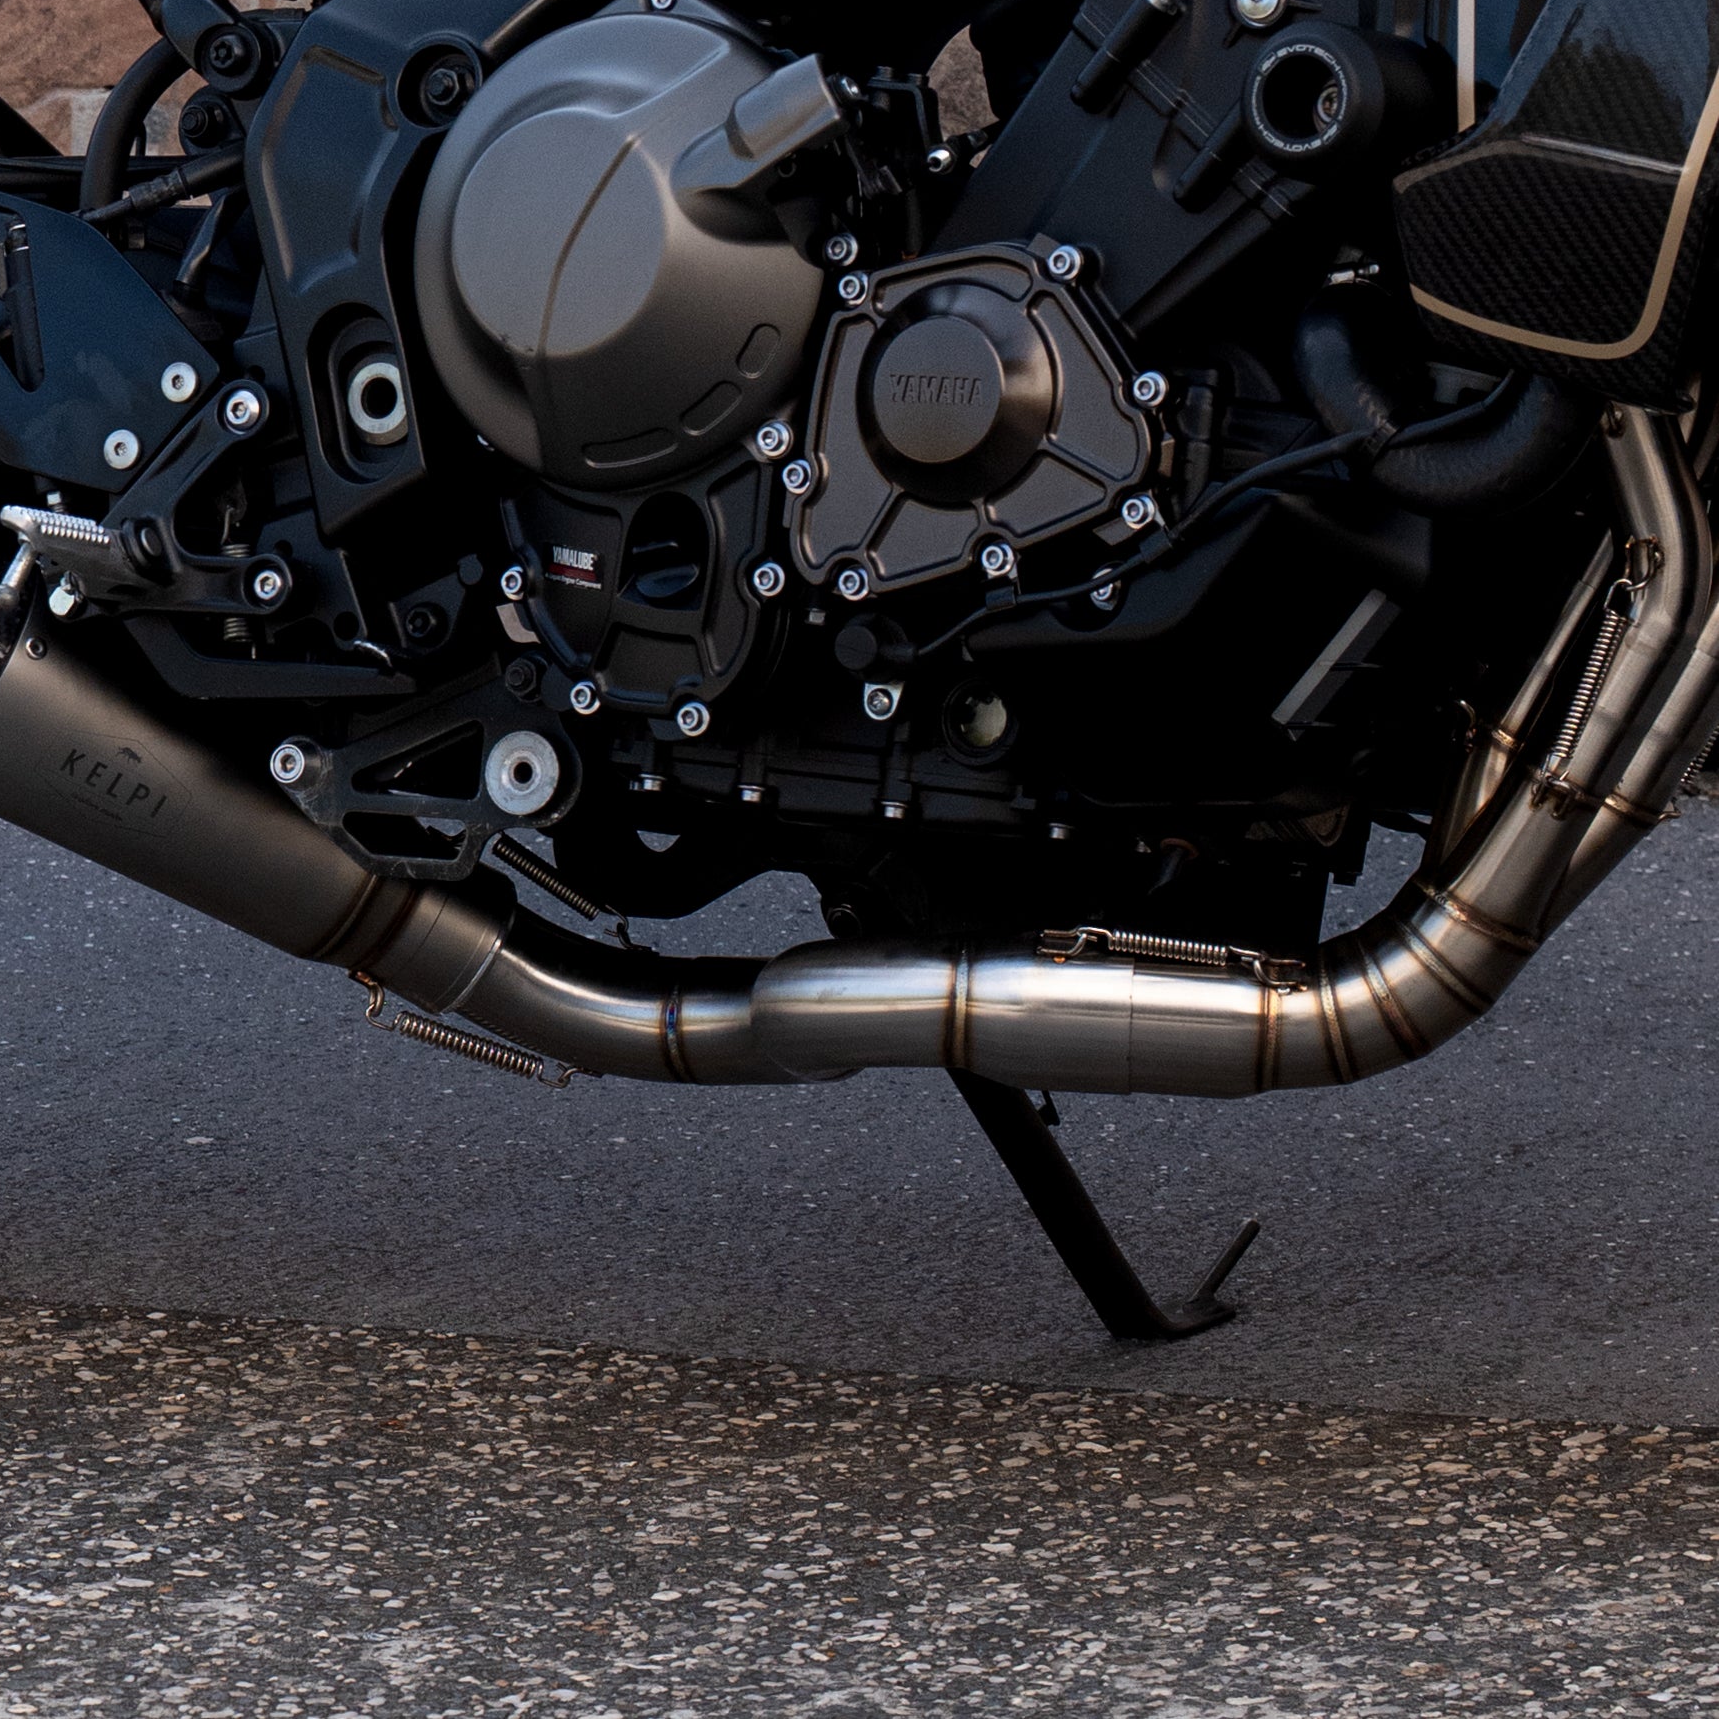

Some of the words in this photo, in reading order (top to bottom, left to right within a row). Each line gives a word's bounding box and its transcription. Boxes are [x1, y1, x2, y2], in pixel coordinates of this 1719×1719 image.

[1277, 44, 1340, 72] EVOTECH
[1258, 123, 1322, 153] EVOTECH
[889, 373, 984, 406] YAMAHA
[553, 545, 594, 571] YAMALUBE
[59, 748, 168, 818] KELPI
